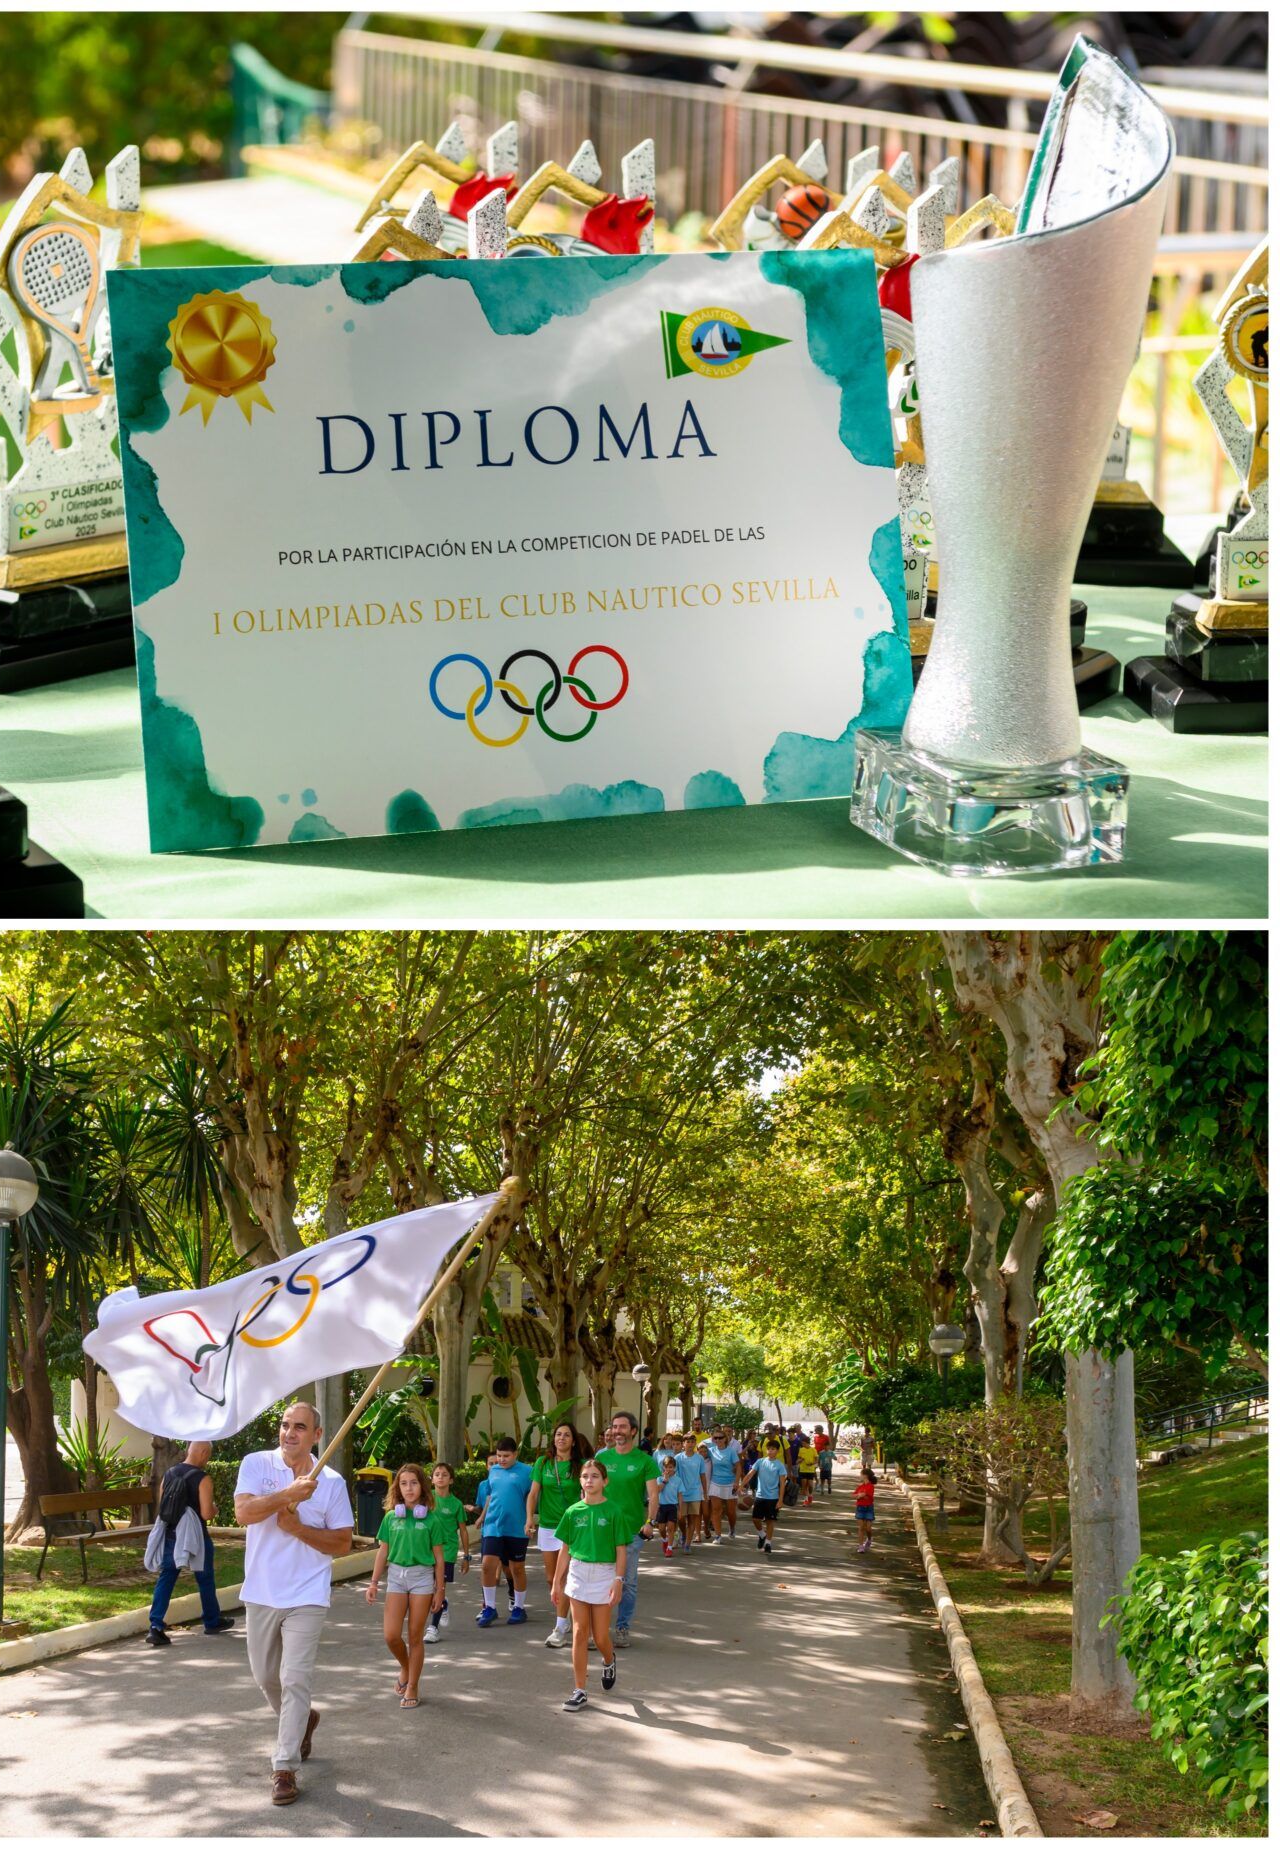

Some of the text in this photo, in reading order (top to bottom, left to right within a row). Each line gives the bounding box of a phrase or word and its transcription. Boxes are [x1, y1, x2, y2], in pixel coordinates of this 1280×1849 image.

[680, 321, 694, 346] CLUB
[698, 363, 742, 376] SEVILLA
[316, 400, 718, 474] DIPLOMA
[62, 480, 122, 499] CLASIFICADO
[66, 496, 112, 512] Olimpiadas
[44, 516, 64, 530] Club
[66, 512, 98, 526] Náutico
[76, 524, 96, 538] 2025
[278, 526, 766, 566] POR LA PARTICIPACIÓN EN LA COMPETICION DE PADEL DE LAS
[213, 577, 840, 635] I OLIMPIADAS DEL CLUB NAUTICO SEVILLA
